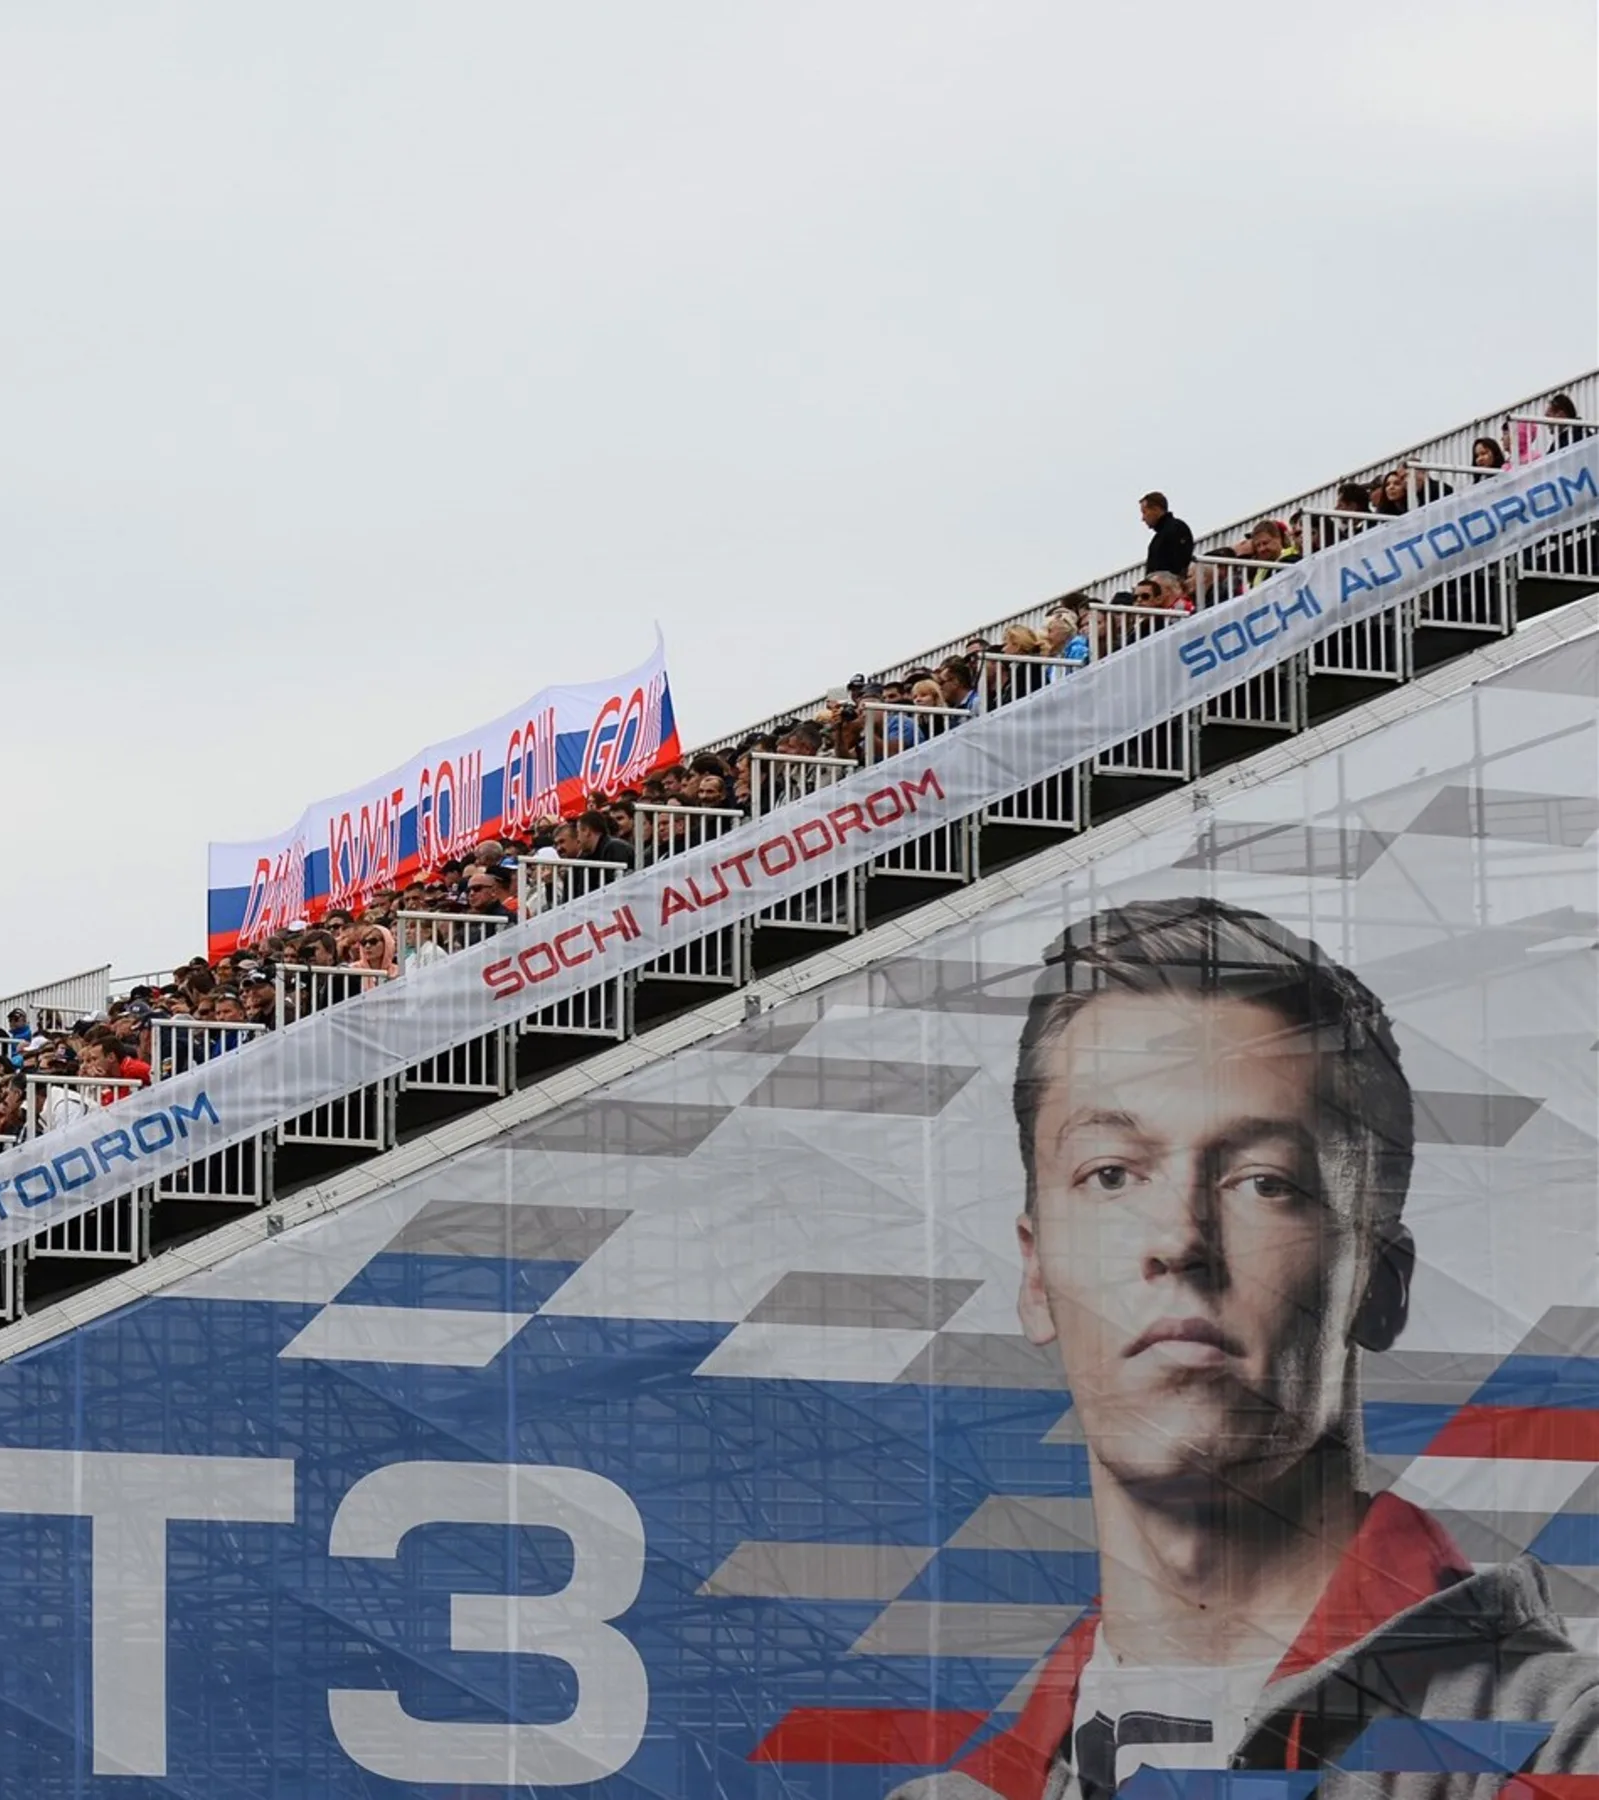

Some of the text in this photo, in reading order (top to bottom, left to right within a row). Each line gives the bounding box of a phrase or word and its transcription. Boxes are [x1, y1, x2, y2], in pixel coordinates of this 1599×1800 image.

[1179, 467, 1598, 678] SOCHI AUTODROM
[482, 768, 945, 999] SOCHI AUTODROM
